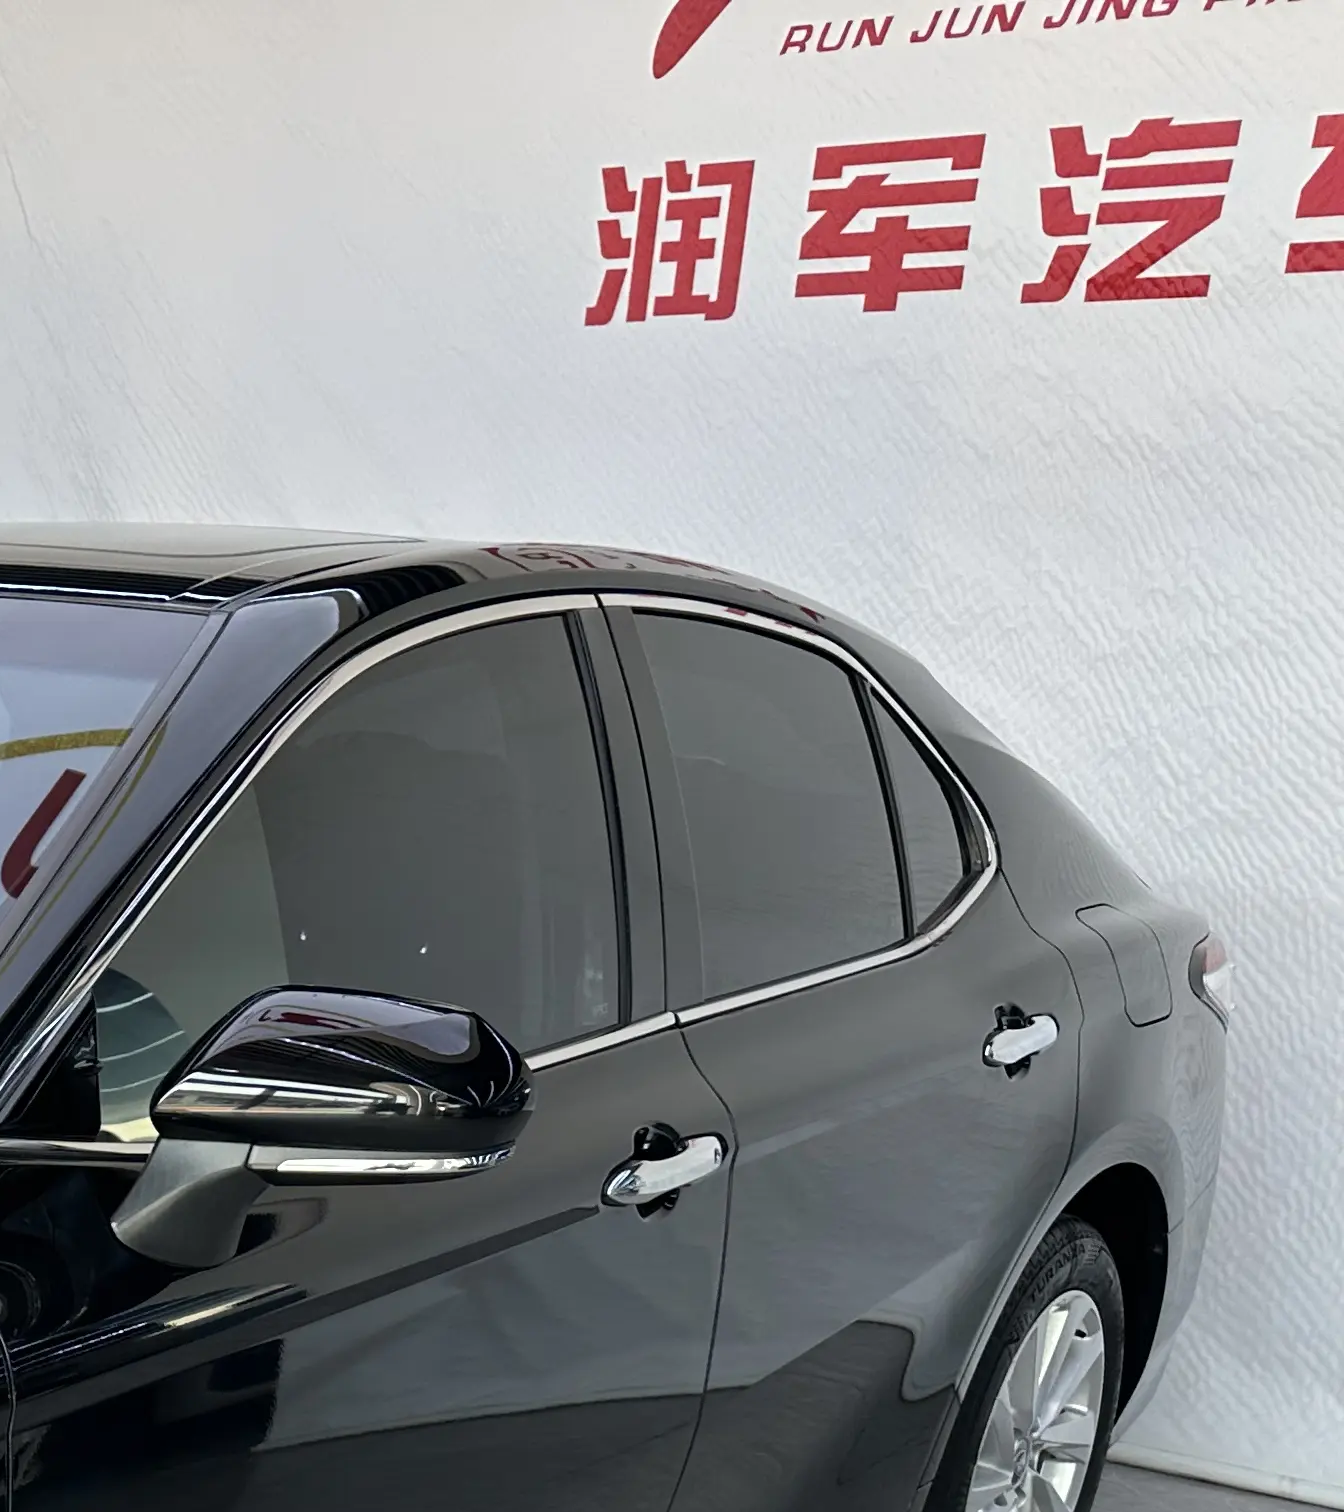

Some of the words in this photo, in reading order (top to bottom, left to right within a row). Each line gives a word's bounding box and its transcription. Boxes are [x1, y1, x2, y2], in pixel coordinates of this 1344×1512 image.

[780, 15, 894, 56] RUN
[910, 0, 1025, 44] JUN
[584, 113, 1344, 327] 润军汽
